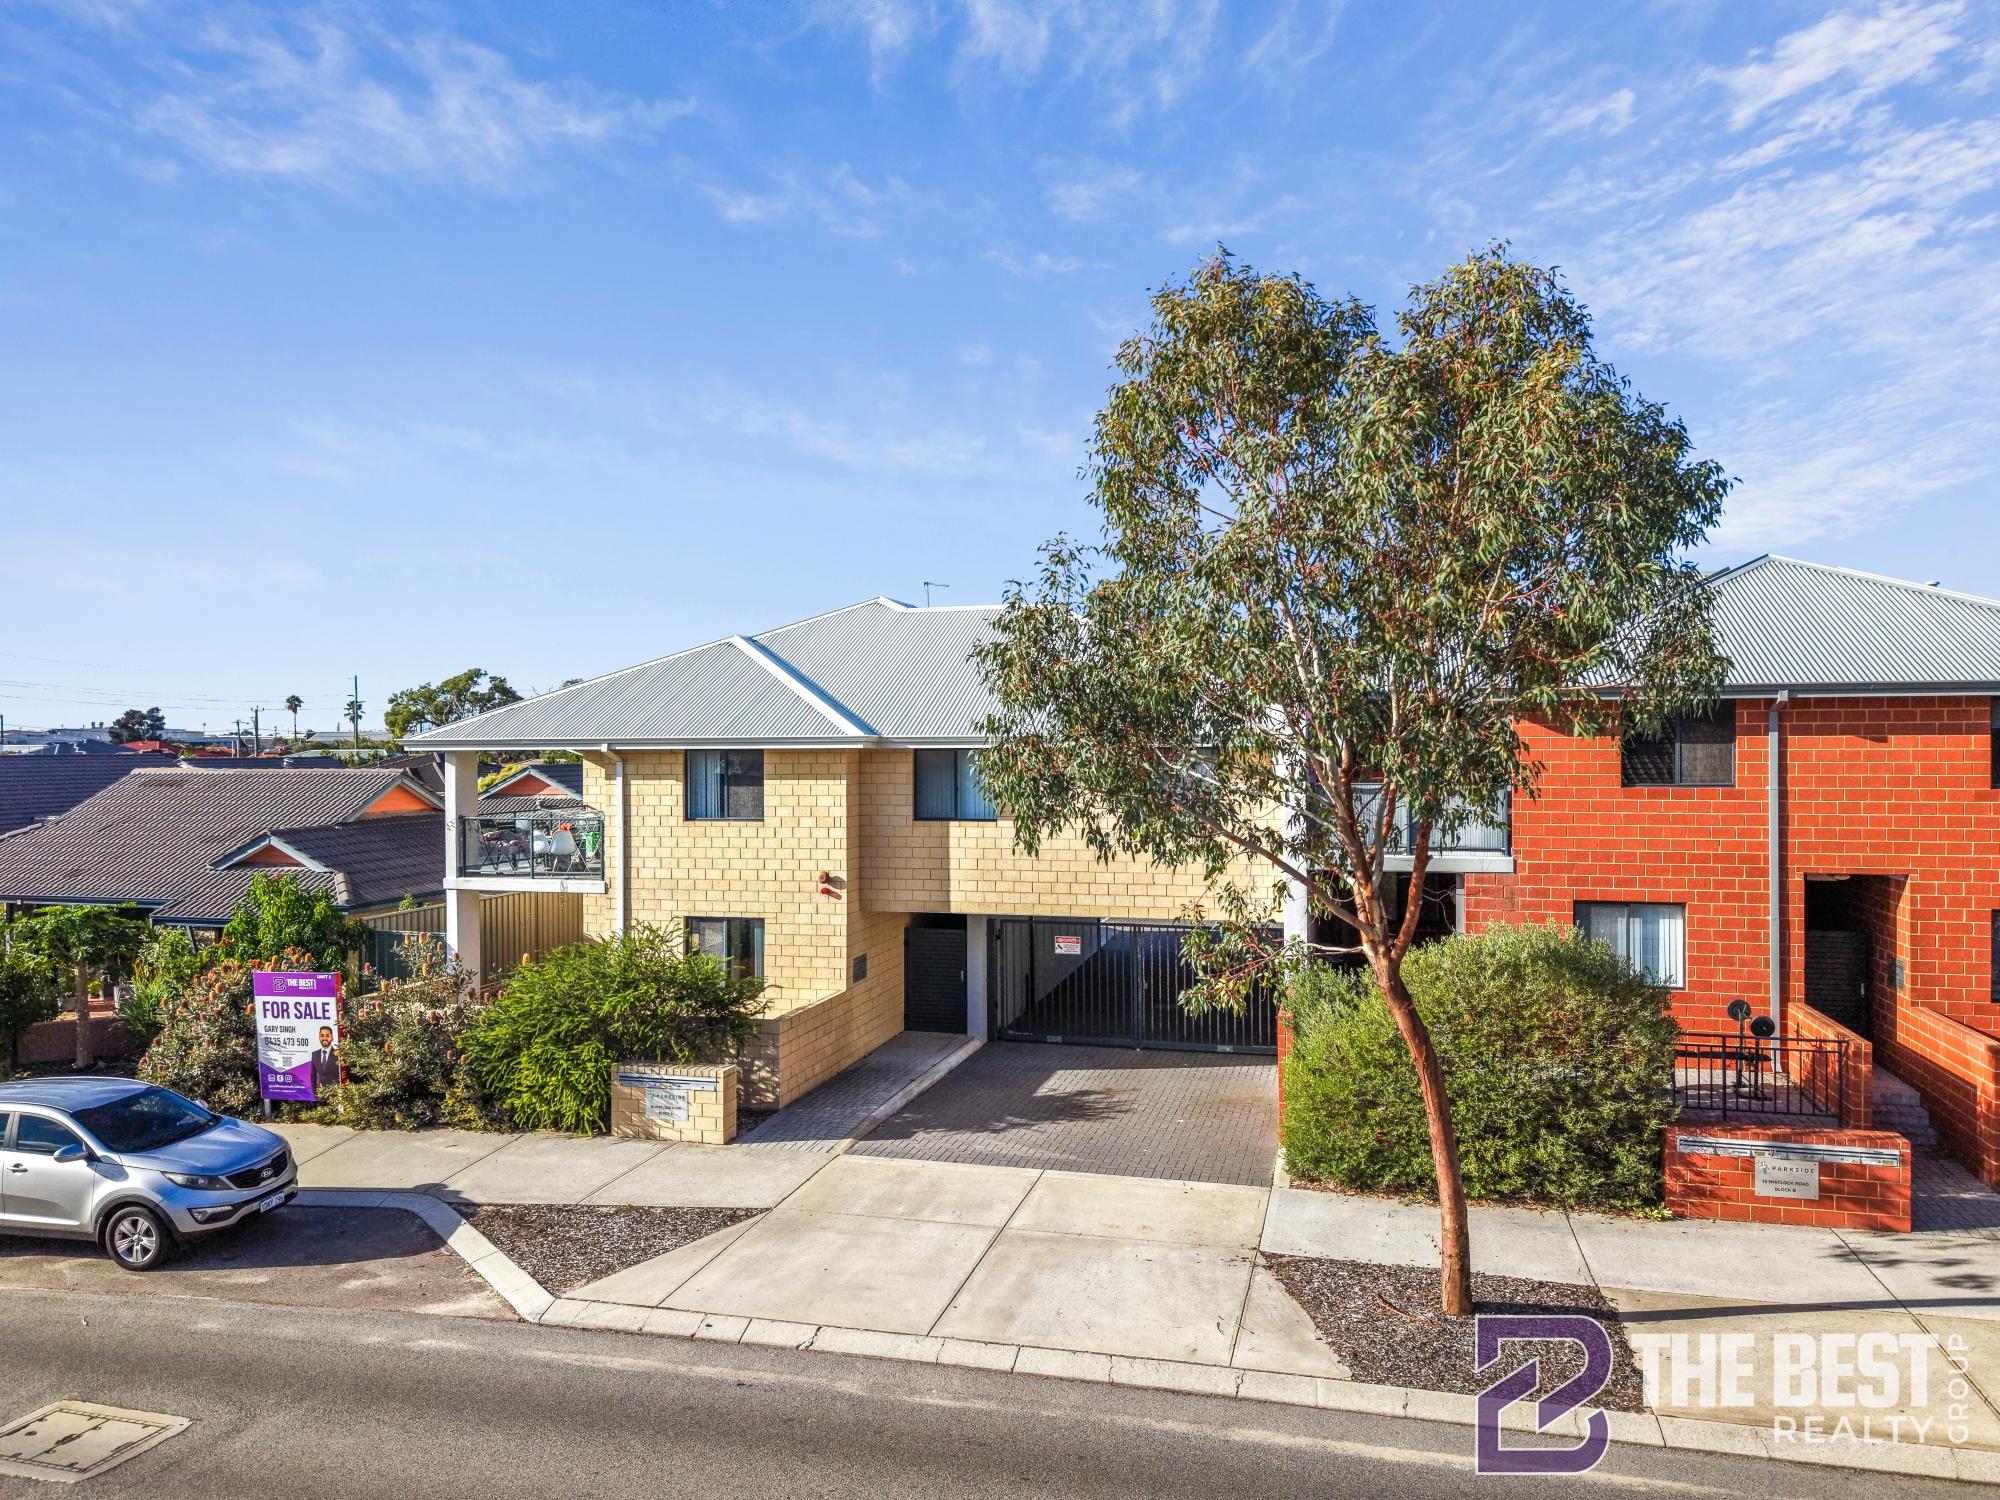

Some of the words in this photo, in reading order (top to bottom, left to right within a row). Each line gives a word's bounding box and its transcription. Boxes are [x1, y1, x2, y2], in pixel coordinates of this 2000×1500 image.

[262, 1001, 290, 1019] FOR
[294, 1002, 330, 1020] SALE
[283, 1038, 295, 1046] 473
[297, 1038, 308, 1046] 500
[1772, 1166, 1815, 1174] PARKSIDE
